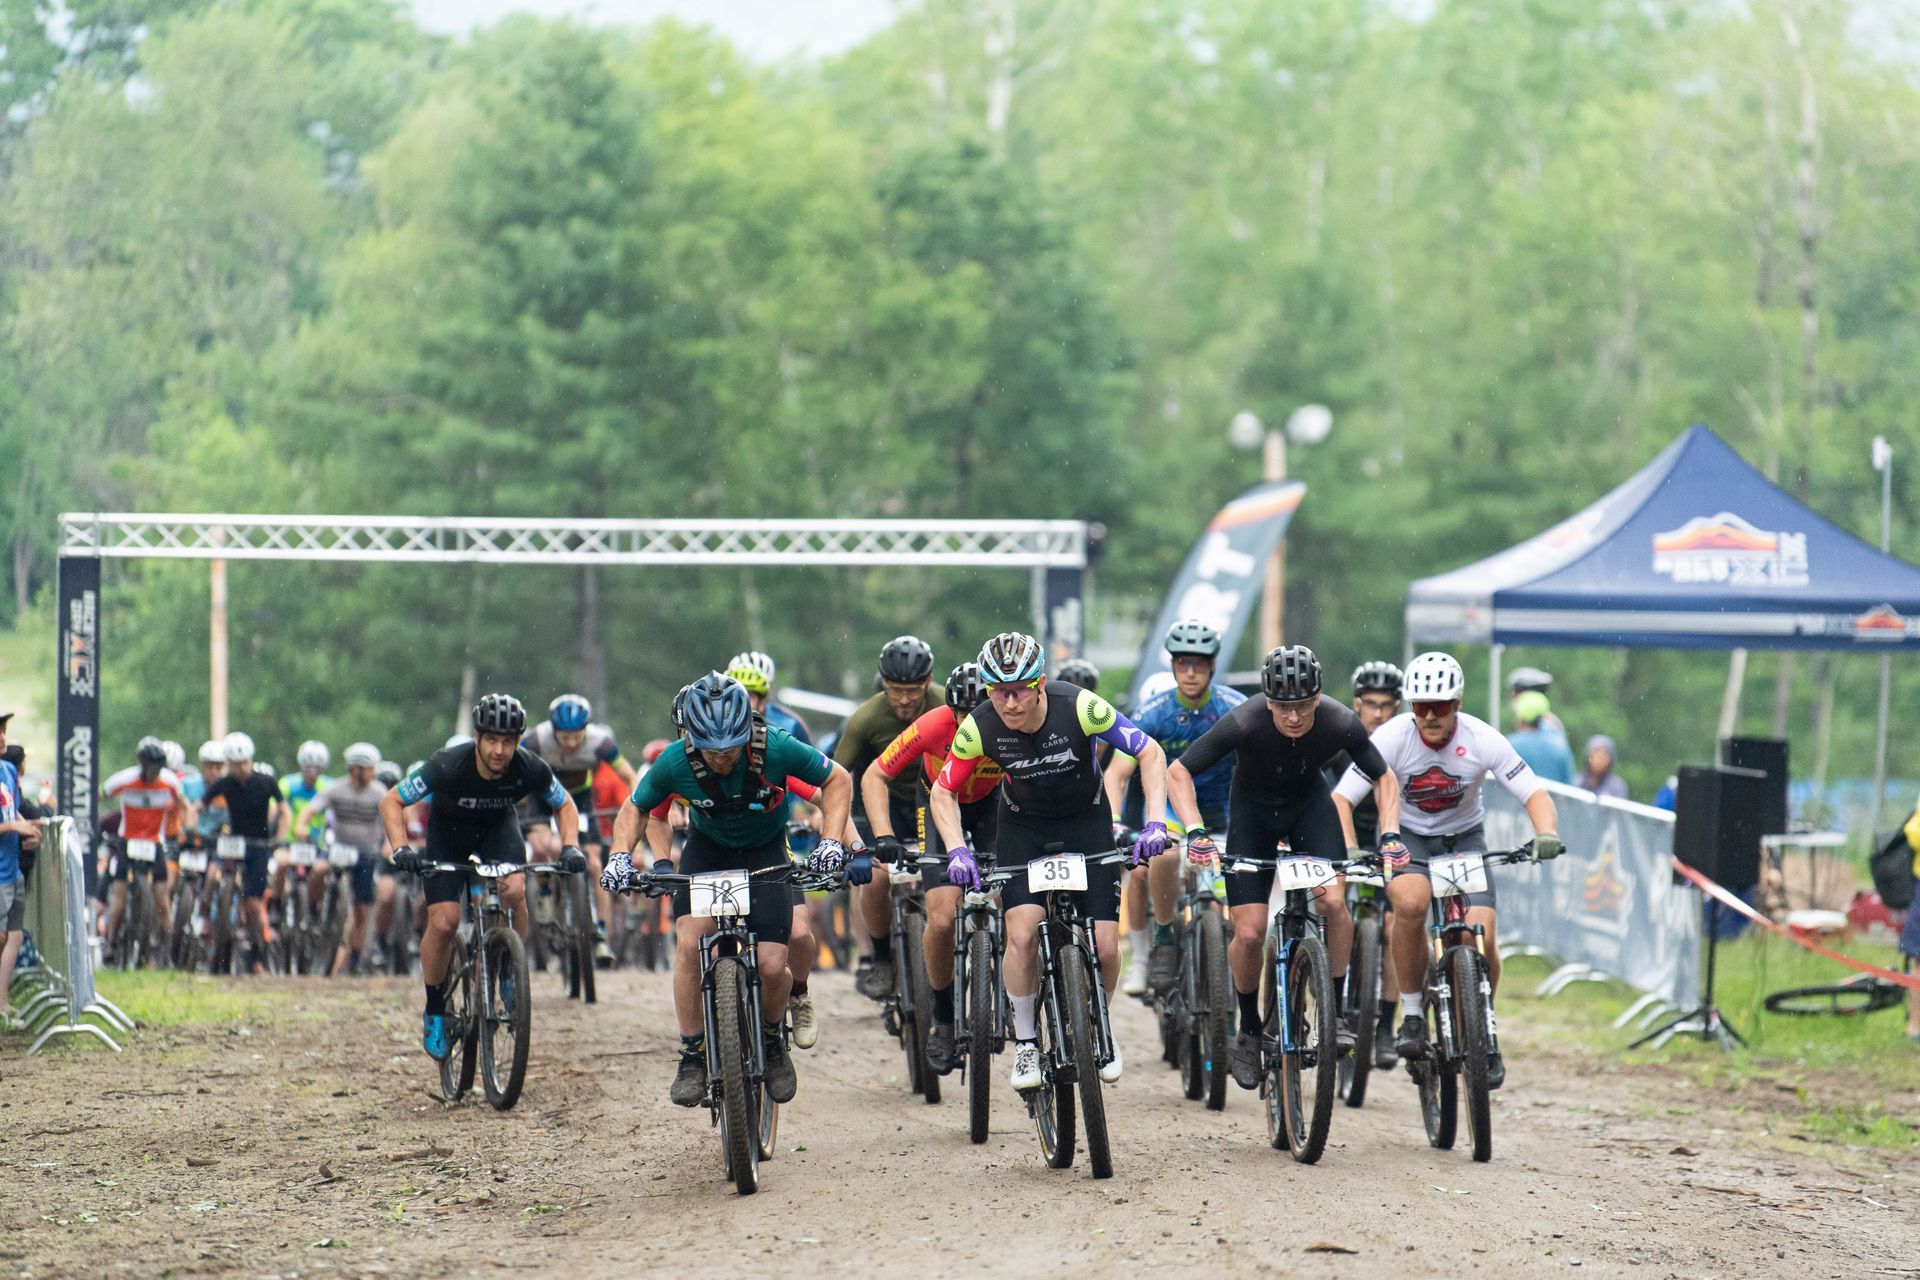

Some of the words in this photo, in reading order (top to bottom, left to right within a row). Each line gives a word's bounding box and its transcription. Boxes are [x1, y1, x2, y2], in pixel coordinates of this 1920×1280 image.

[1042, 735, 1069, 749] CARBS
[1013, 764, 1076, 780] cannondale
[917, 806, 926, 839] WEST
[1043, 860, 1071, 881] 35
[1288, 862, 1327, 879] 118
[1447, 861, 1470, 883] 11
[712, 879, 733, 905] 12
